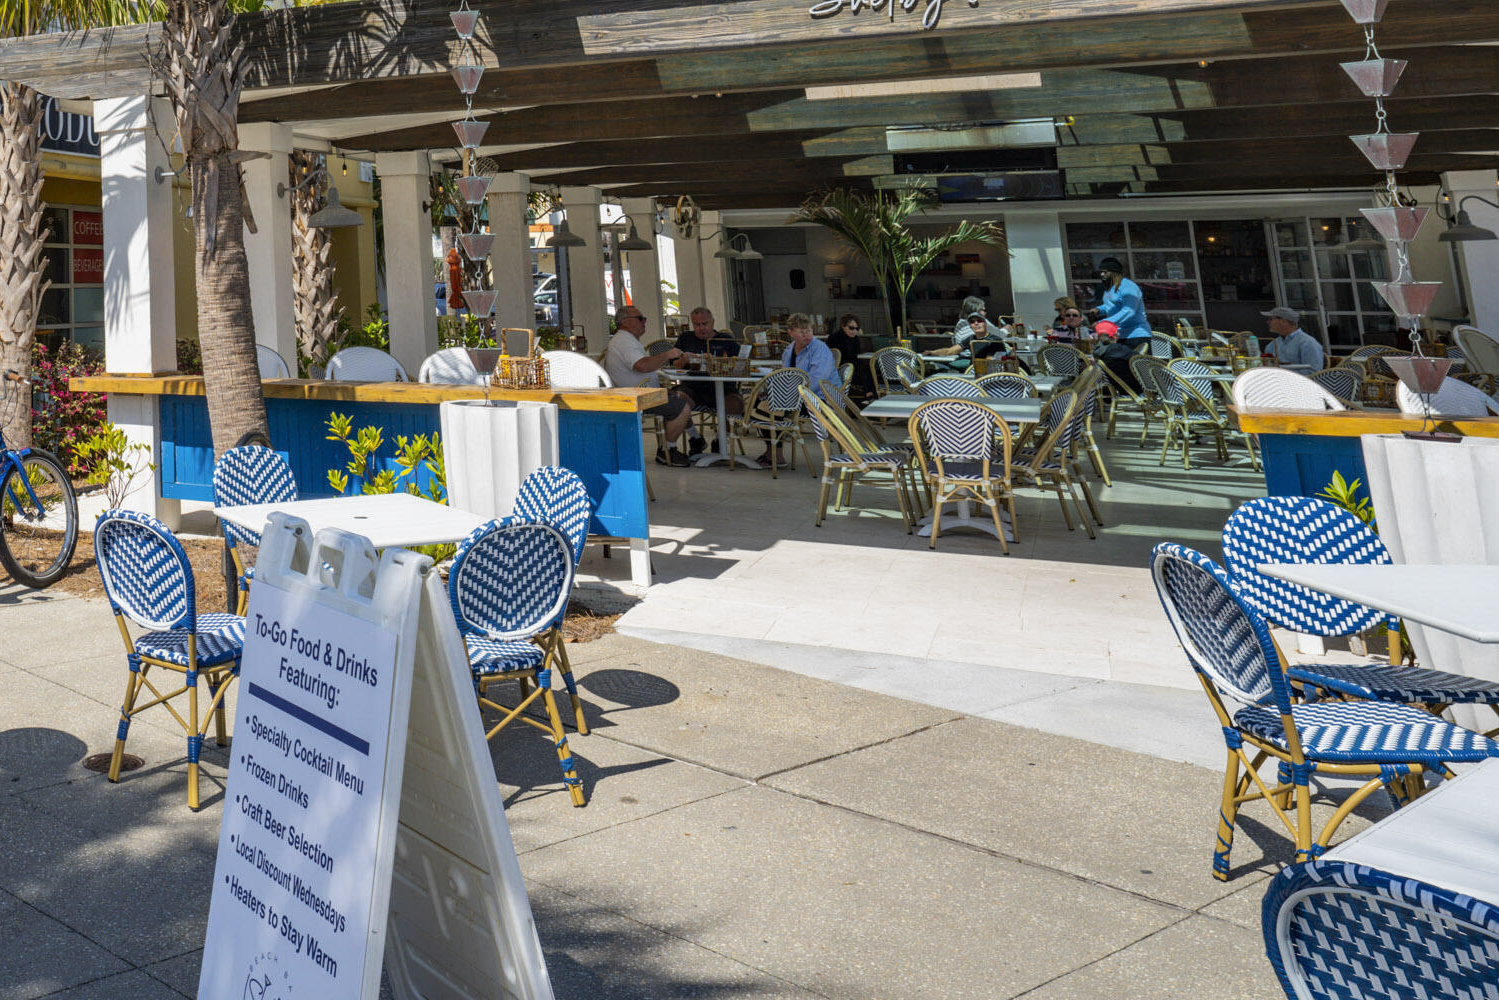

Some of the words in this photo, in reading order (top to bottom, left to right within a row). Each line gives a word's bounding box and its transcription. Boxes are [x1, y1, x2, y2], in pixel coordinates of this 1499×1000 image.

[255, 613, 287, 646] To-Go
[289, 628, 321, 661] Food
[323, 642, 333, 667] &
[336, 647, 378, 687] Drinks
[279, 656, 341, 709] Featuring:
[246, 754, 276, 789] Frozen
[278, 773, 309, 809] Drinks
[251, 715, 292, 757] Specialty
[293, 739, 333, 777] Cocktail
[335, 761, 364, 796] Menu
[241, 794, 263, 825] Craft
[264, 809, 286, 840] Beer
[287, 826, 334, 873] Selection
[235, 834, 256, 864] Local
[256, 850, 292, 892] Discount
[292, 874, 346, 933] Wednesdays
[230, 875, 266, 919] Heaters
[267, 906, 279, 929] to
[280, 916, 304, 953] Stay
[306, 933, 338, 978] Warm
